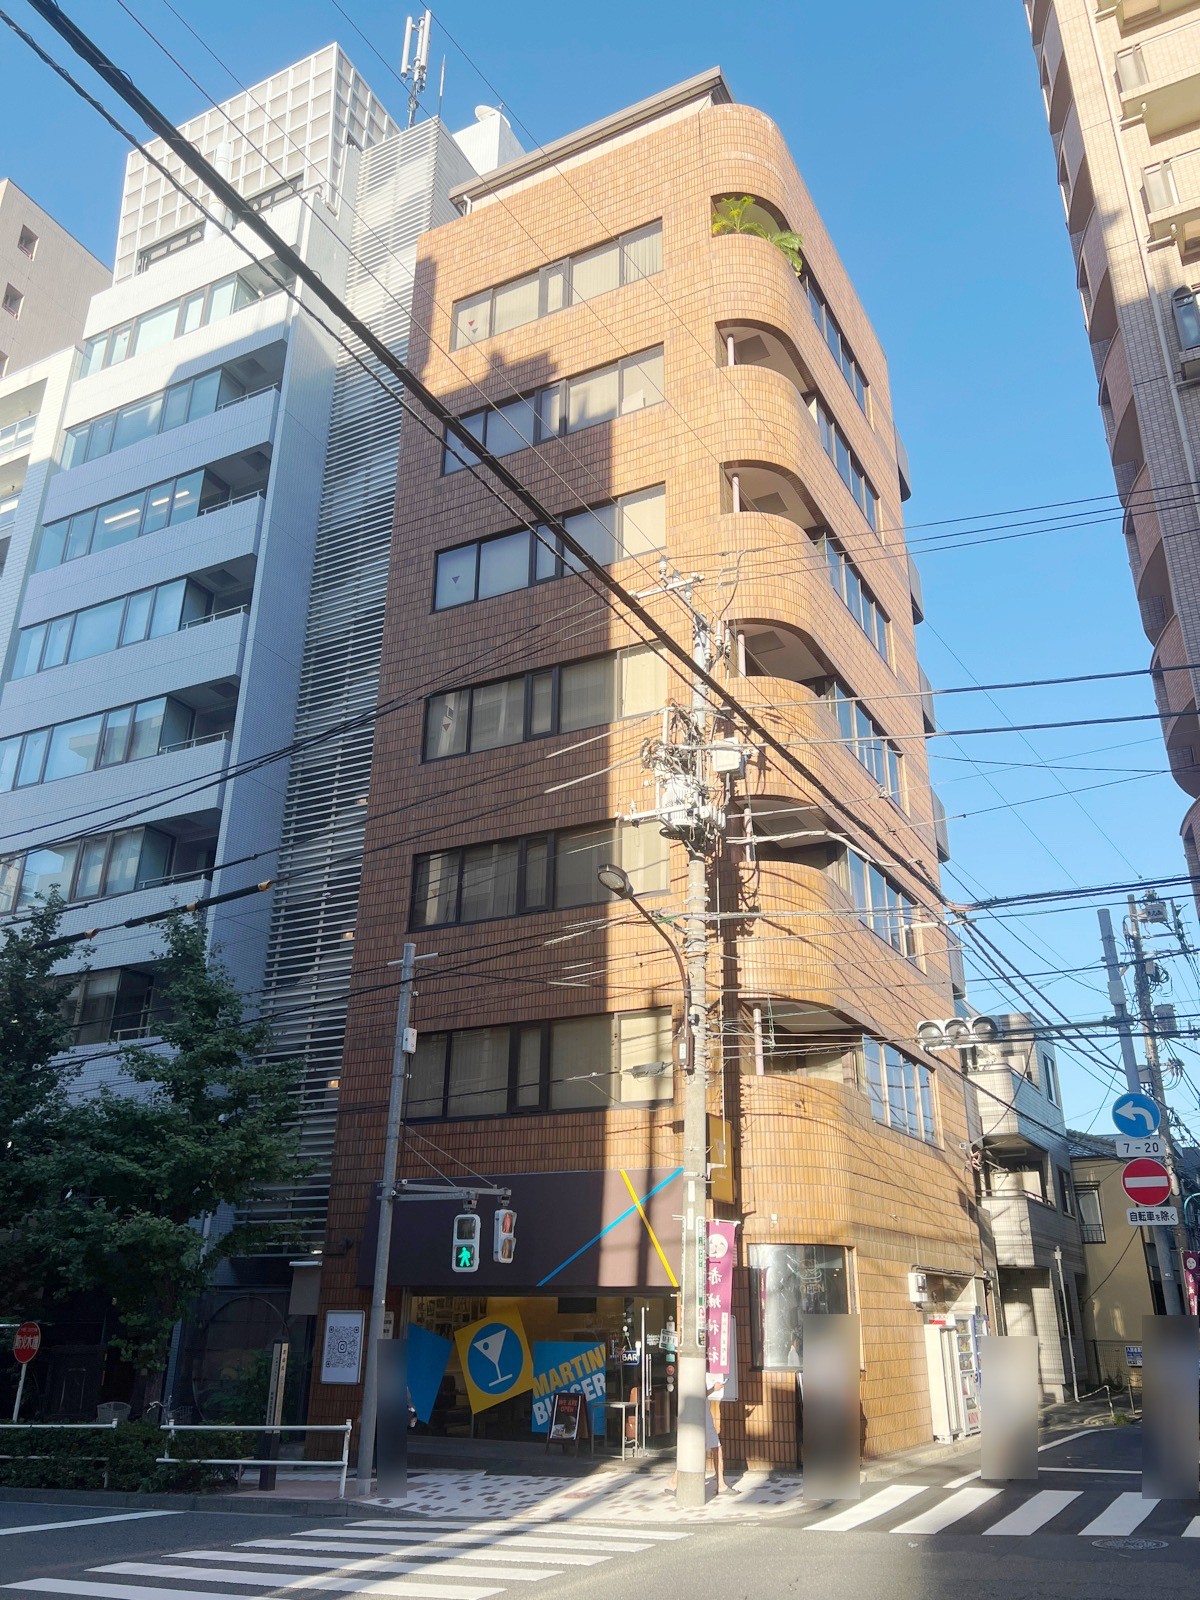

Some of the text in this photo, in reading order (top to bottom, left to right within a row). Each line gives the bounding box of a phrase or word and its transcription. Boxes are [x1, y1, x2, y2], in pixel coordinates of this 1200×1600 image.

[1129, 1210, 1176, 1222] 自転車を除く
[799, 1283, 825, 1294] OPEN
[621, 1353, 638, 1362] BAR
